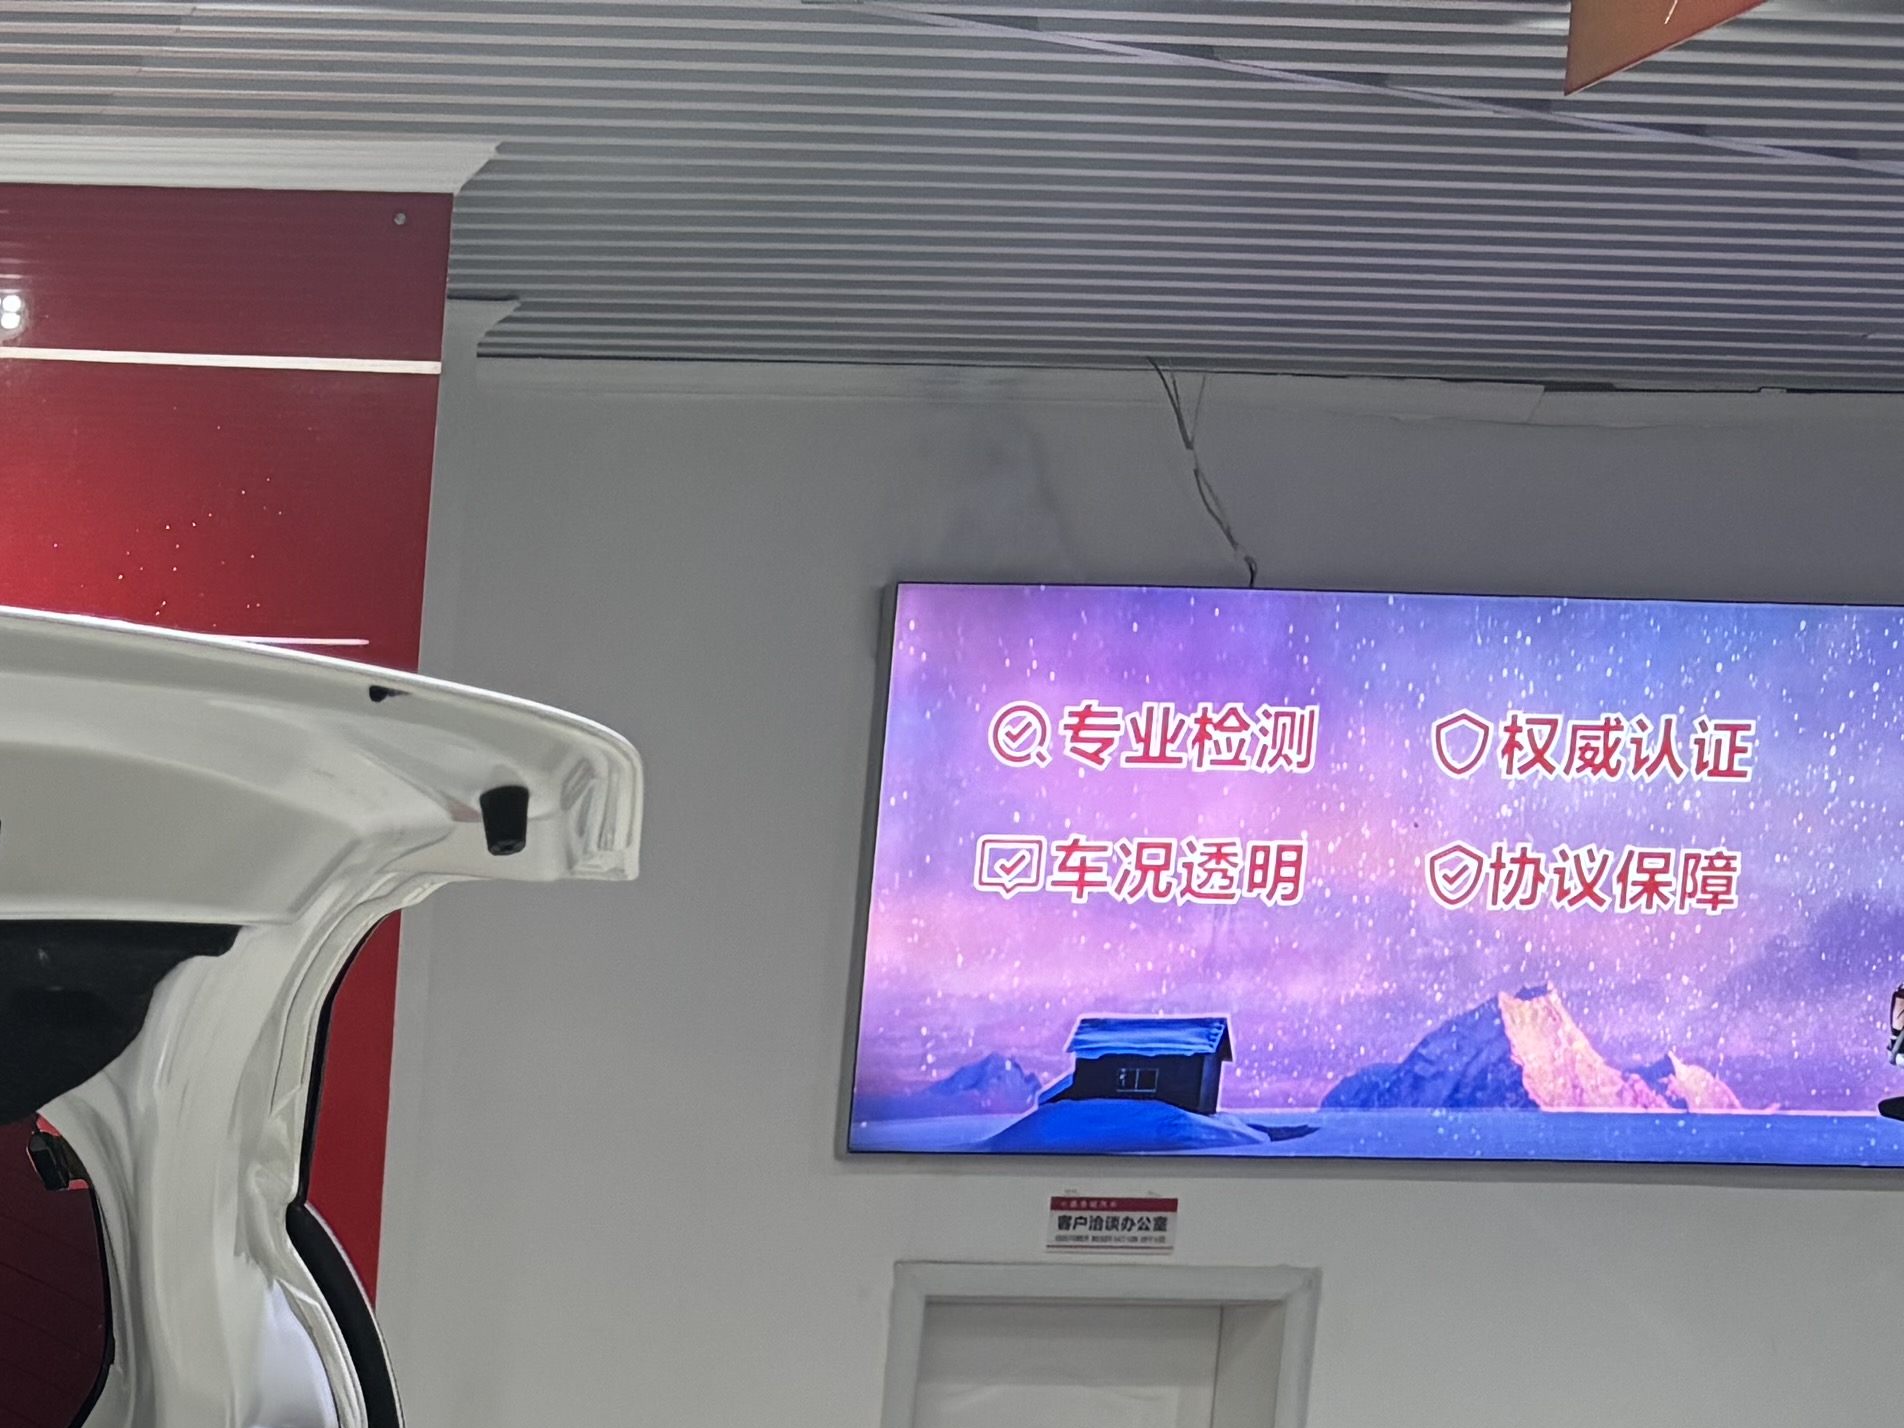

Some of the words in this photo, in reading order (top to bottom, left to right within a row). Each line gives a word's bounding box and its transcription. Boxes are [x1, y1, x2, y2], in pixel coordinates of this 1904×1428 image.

[1060, 701, 1320, 773] 专业检测
[1498, 712, 1754, 782] 权威认证
[1048, 835, 1308, 905] 车况透明
[1489, 842, 1742, 914] 协议保障
[1057, 1214, 1168, 1233] 客户洽谈办公室
